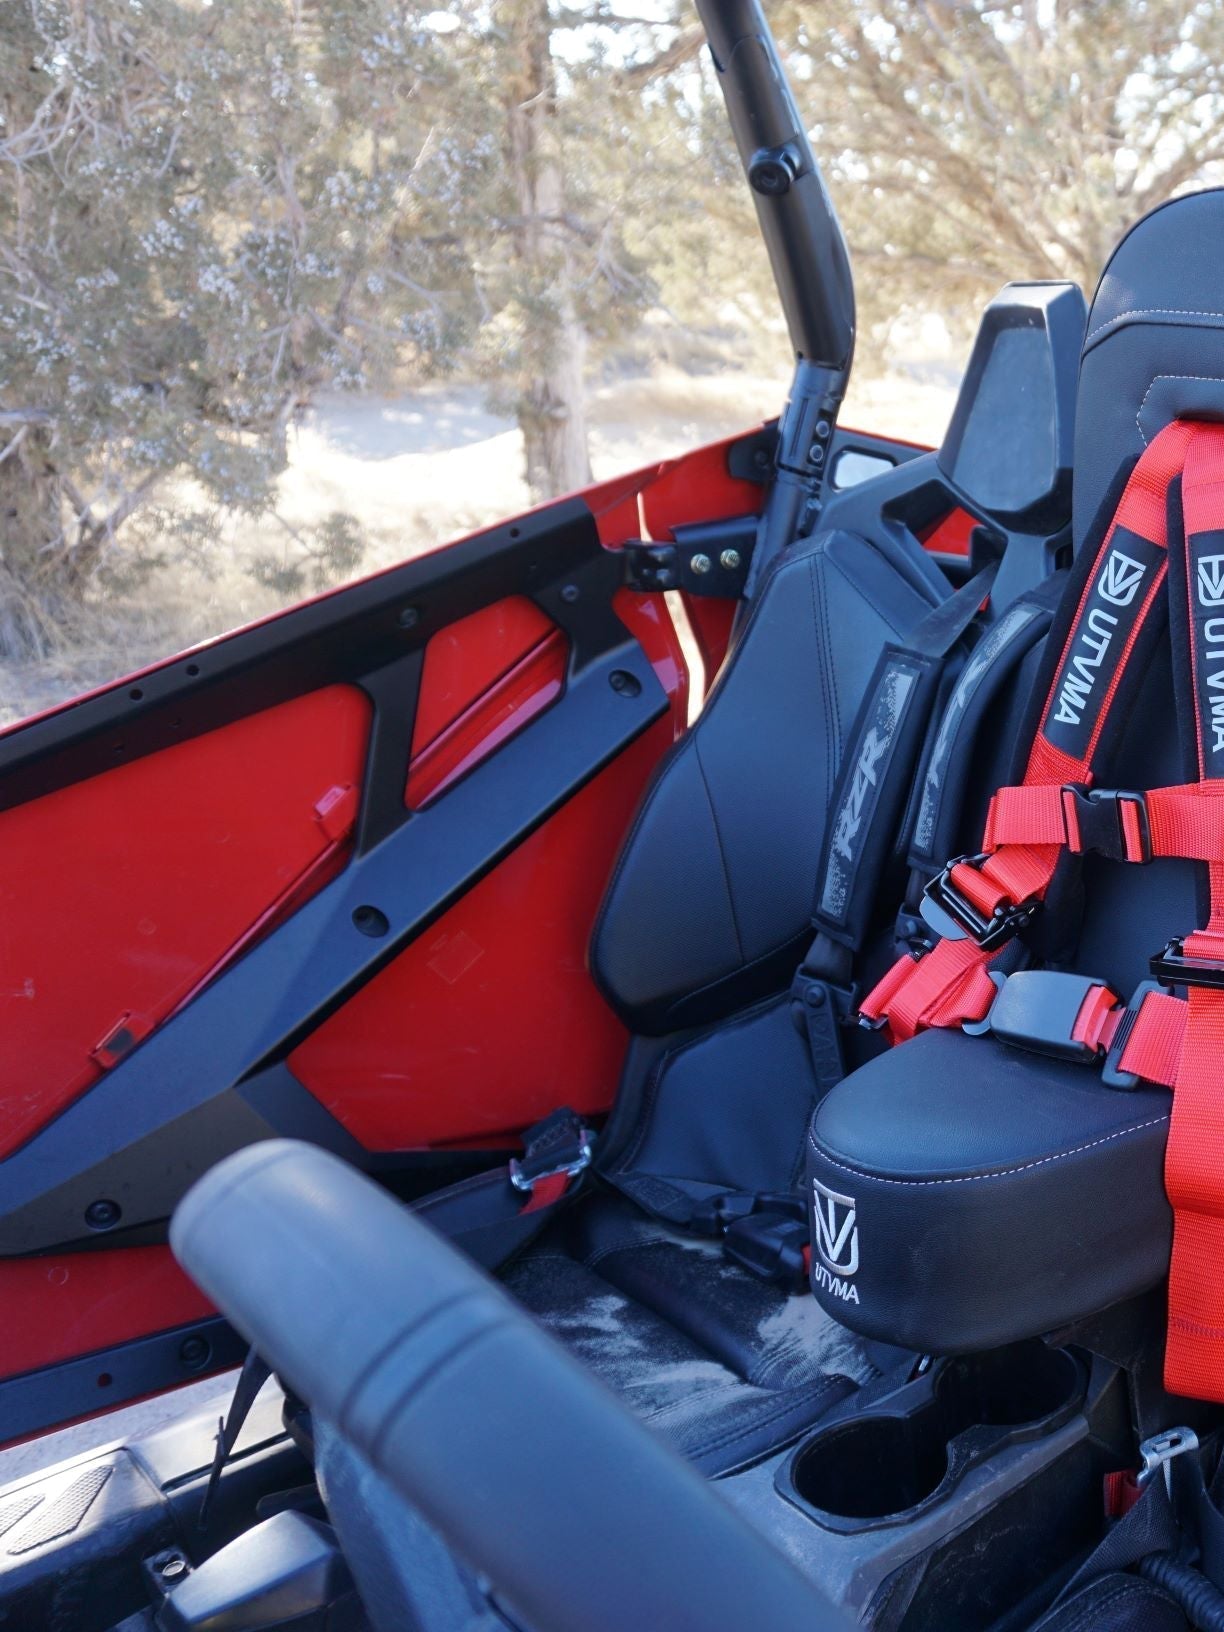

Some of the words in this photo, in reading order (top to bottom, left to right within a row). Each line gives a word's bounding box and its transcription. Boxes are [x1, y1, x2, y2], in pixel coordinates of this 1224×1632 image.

[1054, 608, 1118, 725] UTVMA
[835, 727, 887, 862] RZR
[815, 1262, 860, 1304] UTVMA
